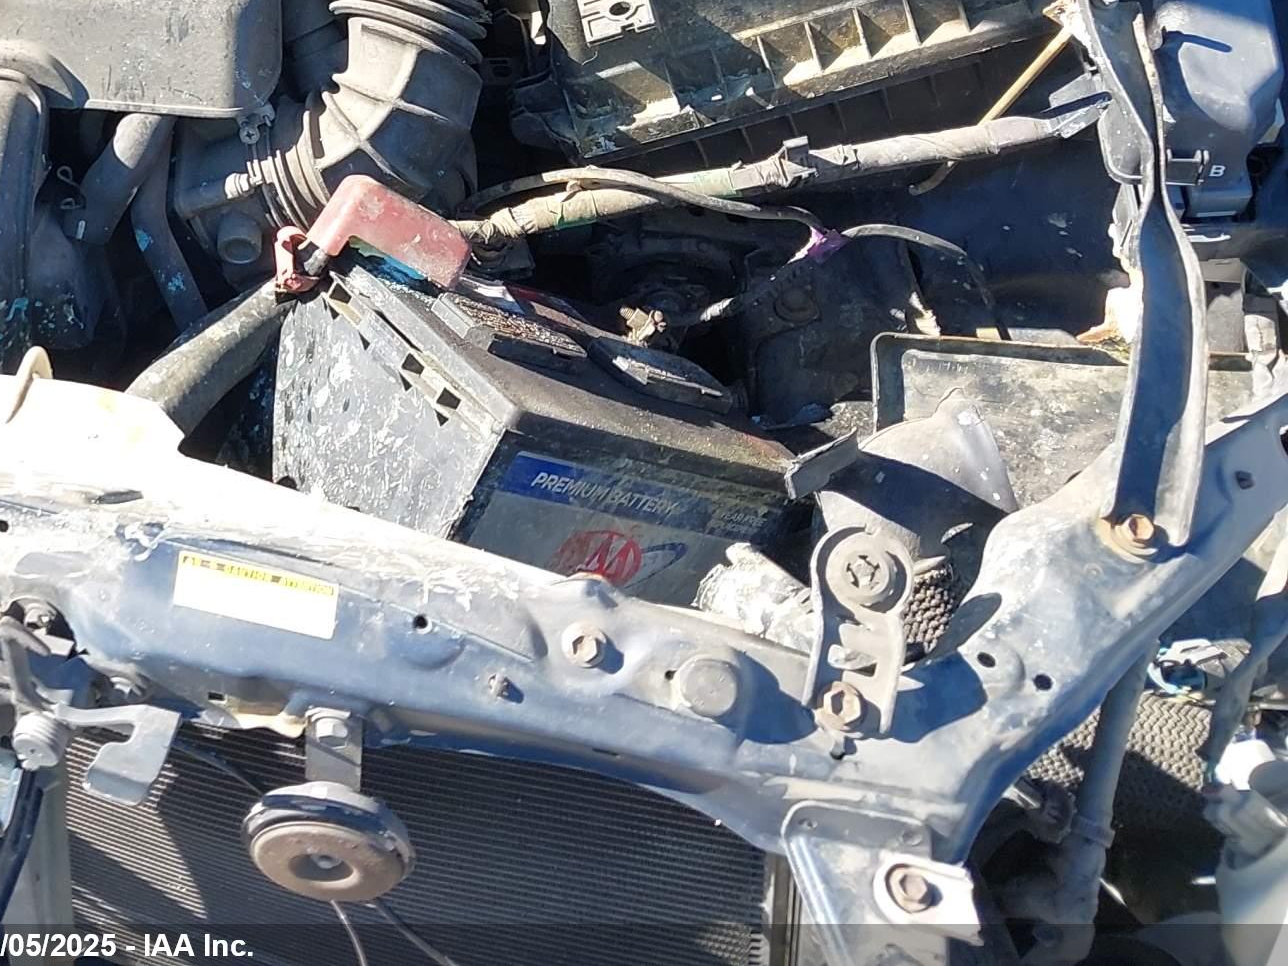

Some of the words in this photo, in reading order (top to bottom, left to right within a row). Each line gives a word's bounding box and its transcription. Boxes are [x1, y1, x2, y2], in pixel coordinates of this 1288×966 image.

[1208, 164, 1227, 177] B
[530, 471, 608, 502] PREMIUM
[608, 487, 680, 516] BATTERY
